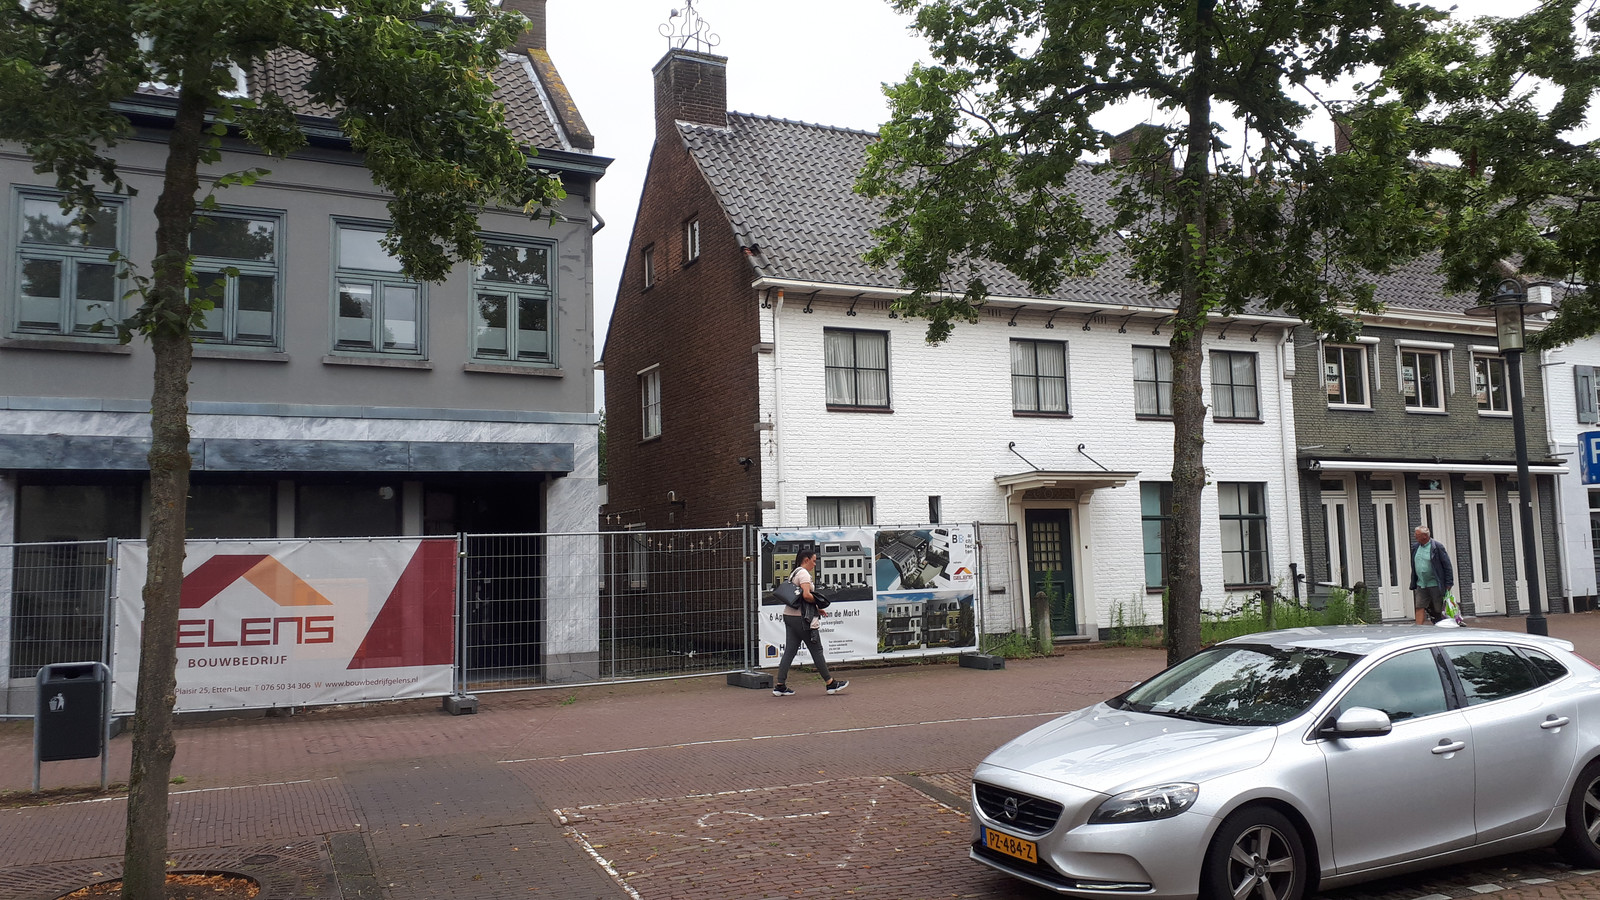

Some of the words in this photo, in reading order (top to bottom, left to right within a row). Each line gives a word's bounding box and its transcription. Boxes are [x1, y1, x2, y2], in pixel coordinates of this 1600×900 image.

[769, 613, 773, 621] 6
[834, 609, 842, 618] de
[842, 608, 860, 618] Markt
[141, 615, 335, 649] ELENS
[188, 655, 288, 668] BOUWBEDRIJF
[174, 686, 197, 695] Plaisir
[199, 686, 210, 694] 25,
[211, 684, 251, 693] Etten-Leur
[260, 683, 275, 691] 076
[276, 683, 286, 691] 50
[287, 682, 296, 690] 34
[298, 682, 311, 690] 306
[325, 676, 419, 688] www.bouwbedrijfgelens.nl
[989, 831, 1033, 860] PZ-484-Z
